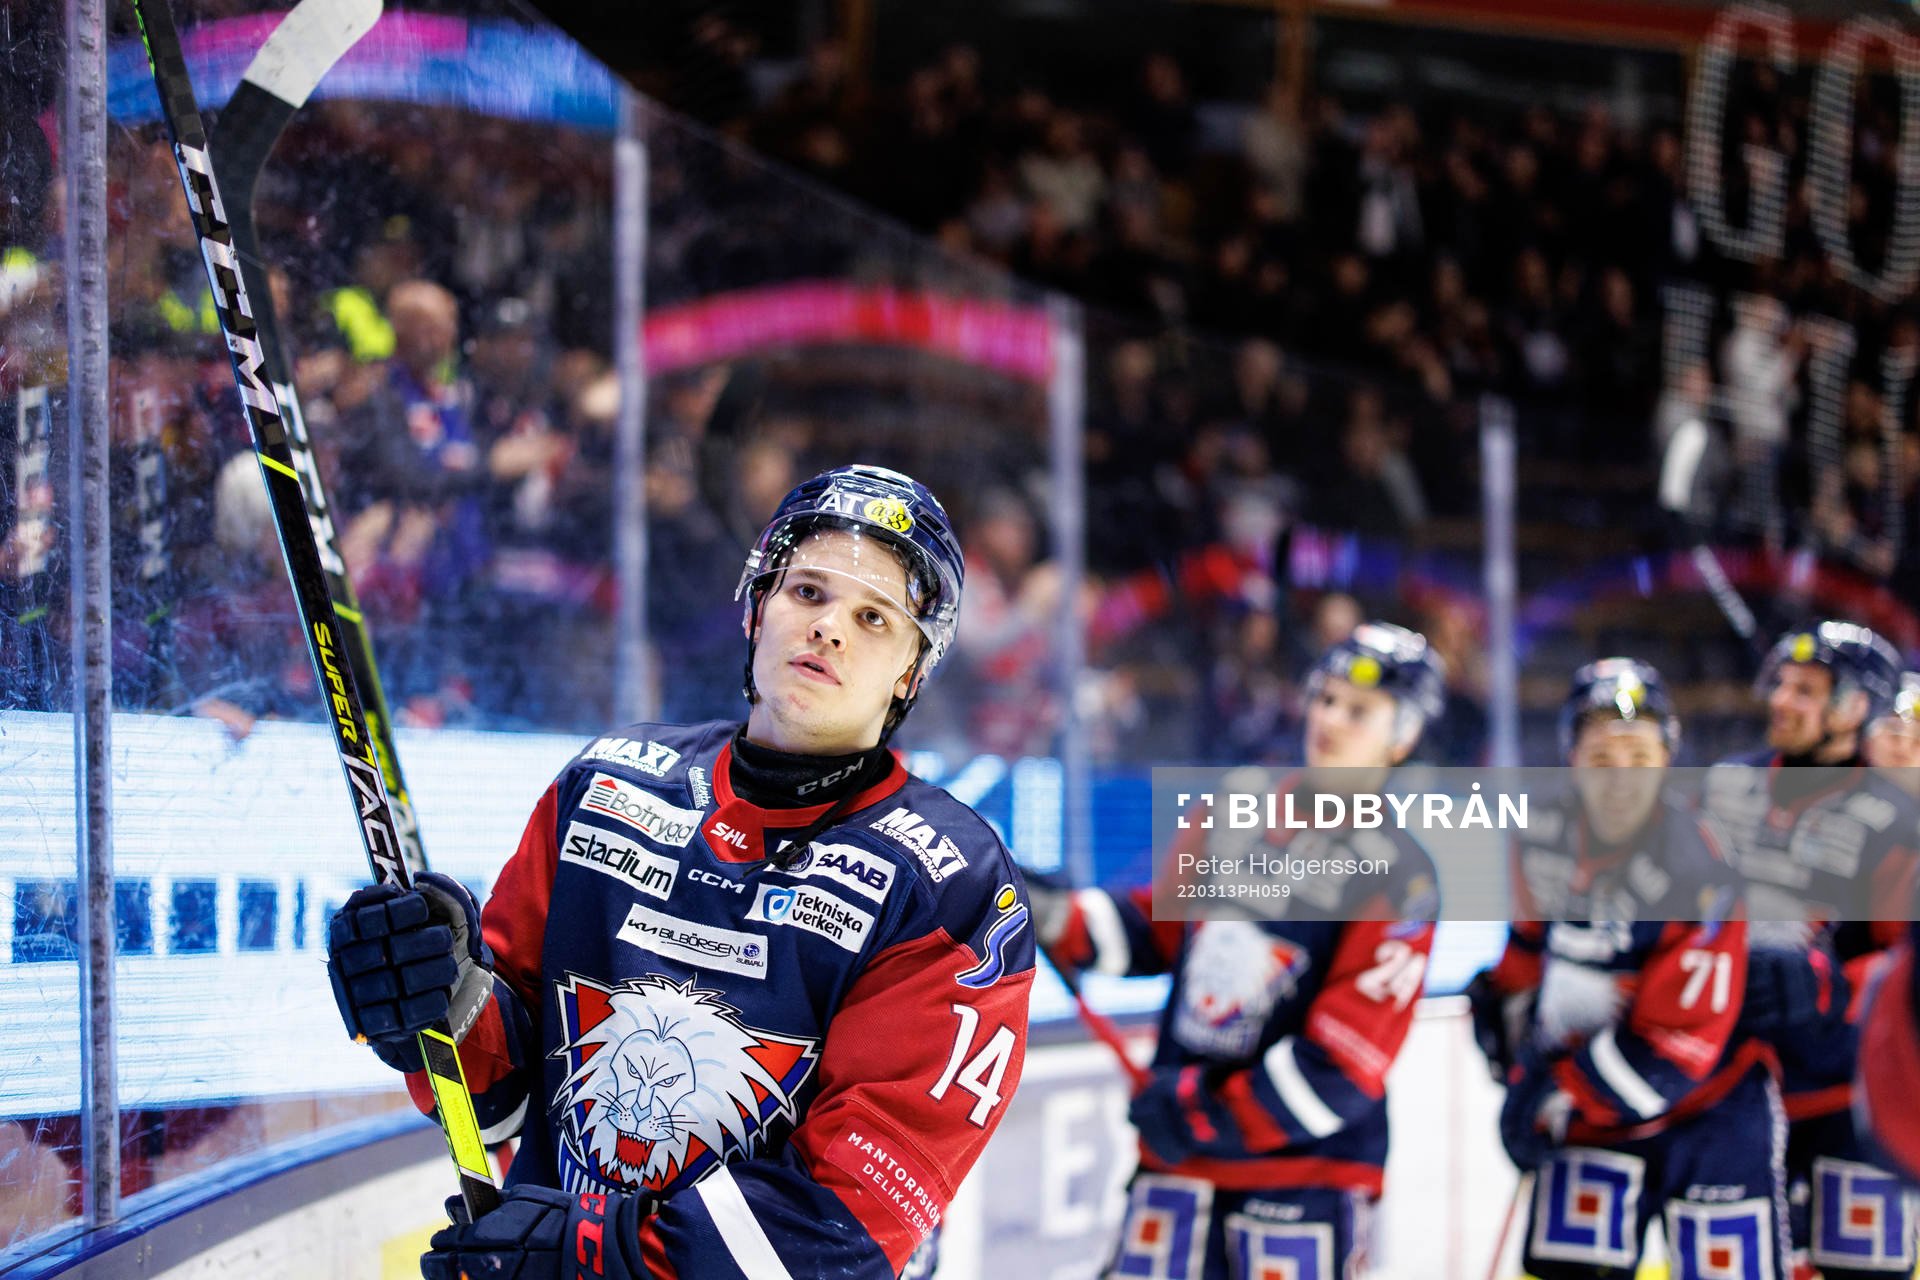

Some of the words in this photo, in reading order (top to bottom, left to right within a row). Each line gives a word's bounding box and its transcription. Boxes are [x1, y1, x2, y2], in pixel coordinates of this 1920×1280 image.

[175, 142, 279, 442] CCM
[313, 621, 360, 745] SUPER
[586, 738, 680, 773] MAXI
[797, 757, 864, 796] CCM
[339, 744, 408, 894] TACK
[610, 792, 694, 844] Botrygg
[710, 822, 749, 850] SHL
[878, 807, 964, 878] MAXI
[566, 834, 672, 893] stadium
[687, 868, 746, 894] CCM
[815, 853, 889, 891] SAAB
[792, 908, 843, 940] verken
[796, 892, 863, 933] Tekniska
[658, 927, 741, 956] BILBÖRSEN
[736, 957, 764, 968] SUBARU
[1354, 938, 1427, 1014] 24
[1679, 949, 1733, 1014] 71
[930, 1003, 1023, 1129] 14
[576, 1192, 607, 1280] CC
